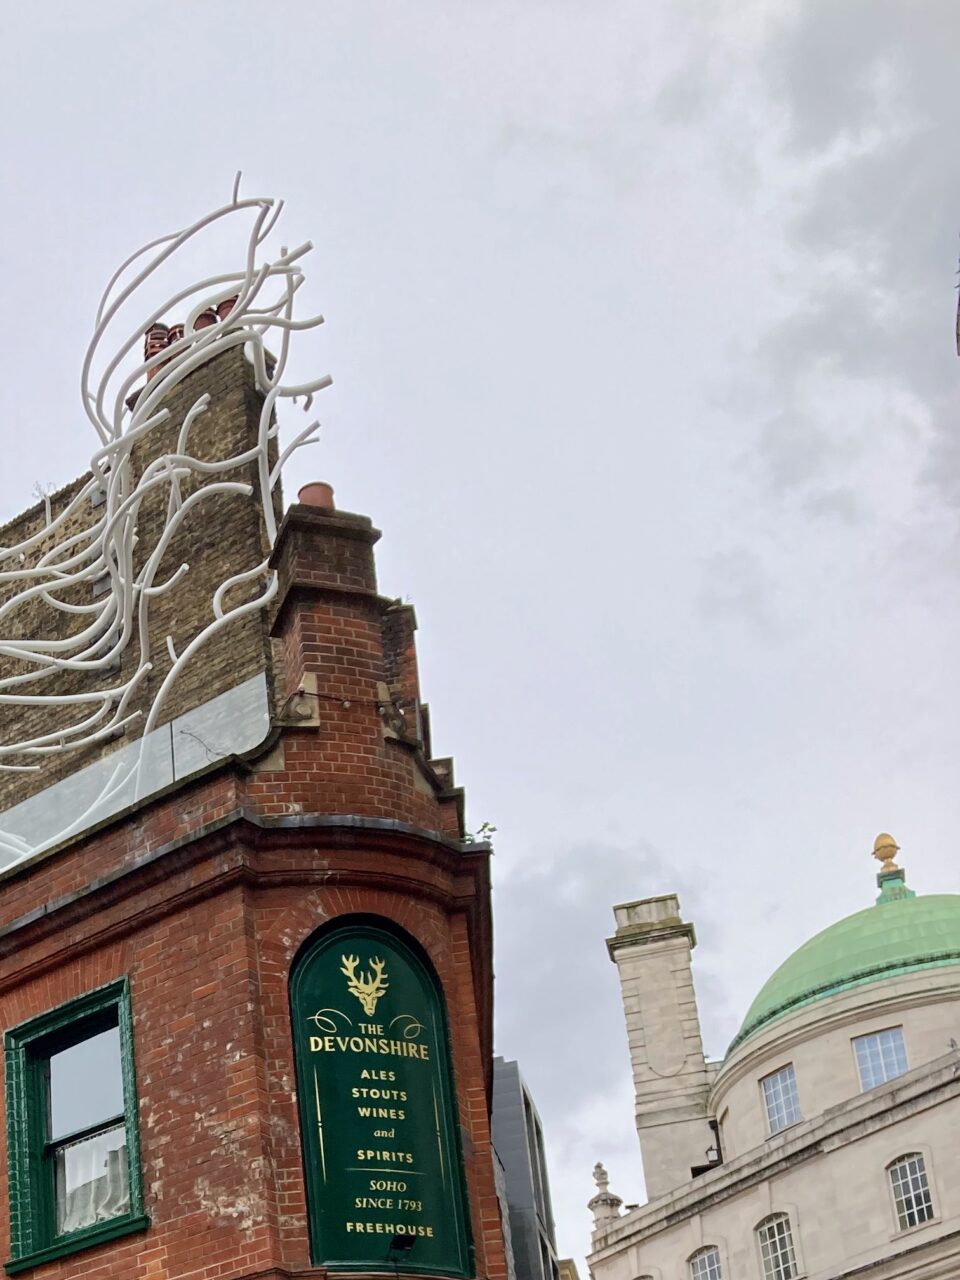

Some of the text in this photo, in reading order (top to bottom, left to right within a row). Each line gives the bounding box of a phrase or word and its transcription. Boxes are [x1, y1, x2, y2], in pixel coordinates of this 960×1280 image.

[358, 1024, 385, 1036] THE
[309, 1036, 430, 1060] DEVONSHIRE
[360, 1069, 396, 1081] ALES
[352, 1088, 407, 1101] STOUTS
[358, 1107, 405, 1120] WINES
[373, 1128, 395, 1139] and
[357, 1149, 413, 1164] SPIRITS
[369, 1180, 407, 1193] SOHO
[355, 1198, 422, 1212] SINCE 1793
[346, 1222, 434, 1238] FREEHOUSE
